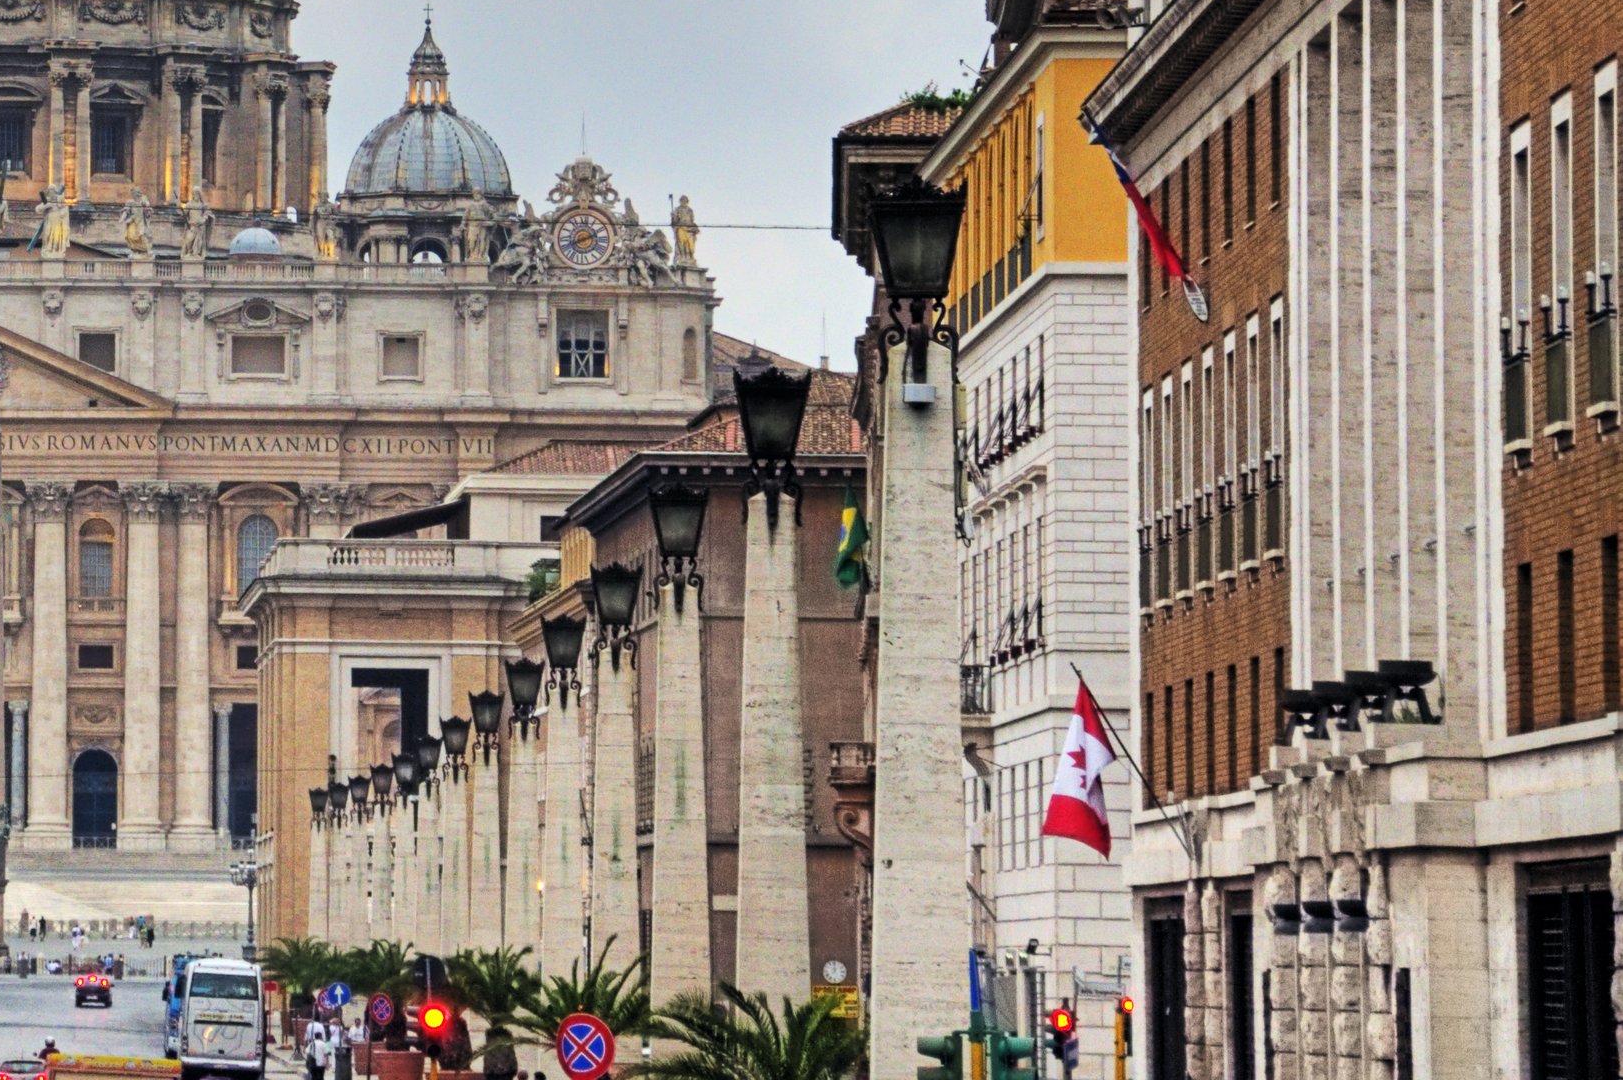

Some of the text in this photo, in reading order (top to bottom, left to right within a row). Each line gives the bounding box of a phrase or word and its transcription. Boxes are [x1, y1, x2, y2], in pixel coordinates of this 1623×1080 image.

[47, 433, 157, 451] ROMANVS
[163, 435, 220, 452] PONT
[221, 435, 268, 452] MAX
[270, 436, 300, 452] AN
[398, 437, 456, 454] PONT
[462, 438, 492, 454] VII
